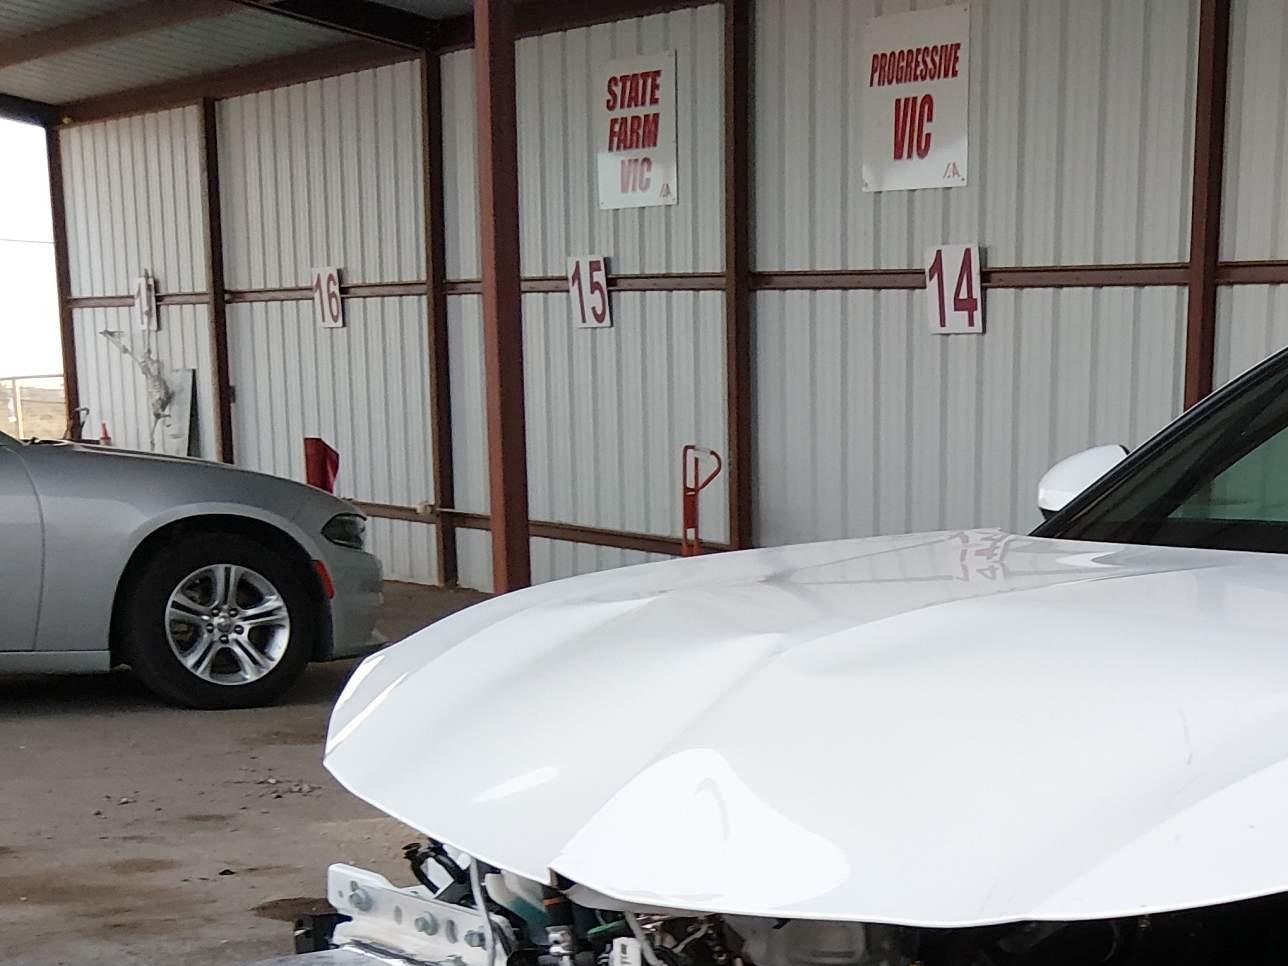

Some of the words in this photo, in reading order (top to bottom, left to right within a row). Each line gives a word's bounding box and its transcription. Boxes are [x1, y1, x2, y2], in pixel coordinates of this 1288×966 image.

[869, 42, 962, 88] PROGRESSIVE
[606, 69, 662, 112] STATE
[608, 112, 660, 153] FARM
[893, 93, 935, 161] VIC
[620, 156, 653, 194] VIC
[137, 281, 153, 326] 1
[314, 272, 340, 323] 16
[571, 260, 607, 324] 15
[928, 247, 978, 328] 14
